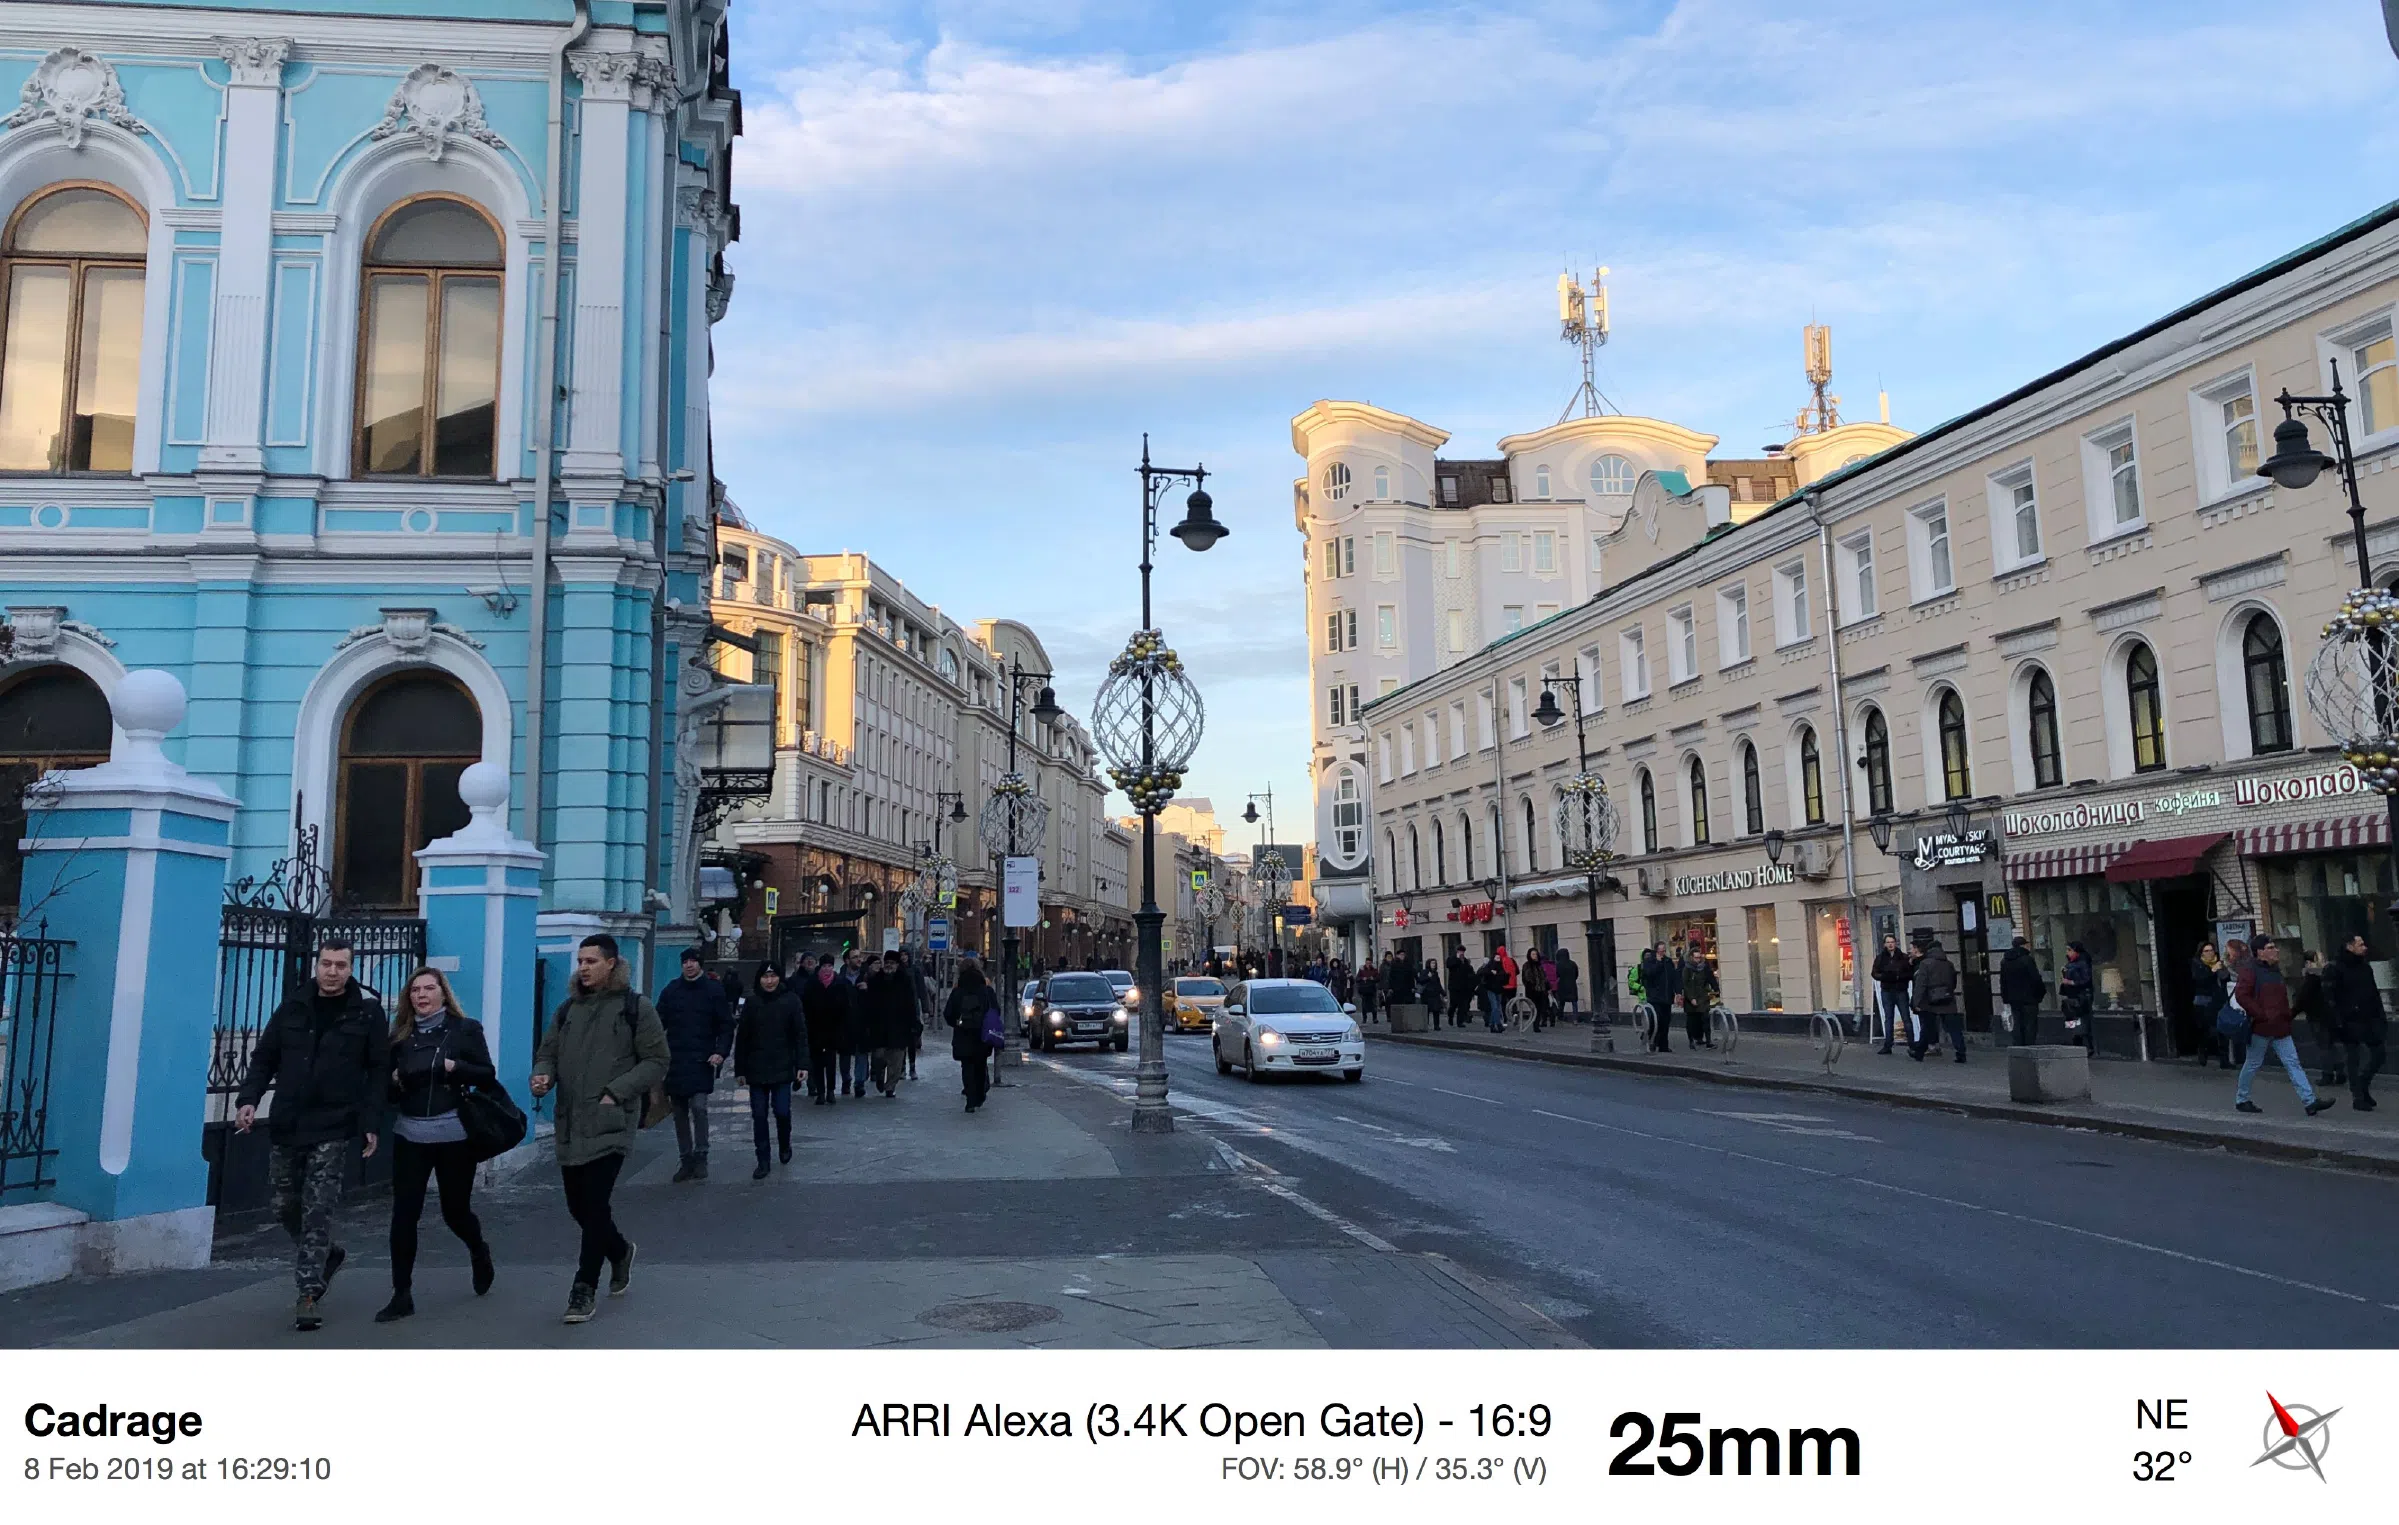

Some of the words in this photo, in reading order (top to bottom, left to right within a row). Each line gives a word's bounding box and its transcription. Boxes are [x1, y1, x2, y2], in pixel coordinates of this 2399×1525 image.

[2154, 790, 2219, 816] кофейня
[2004, 802, 2144, 837] Шоколадница
[1935, 829, 1987, 845] MYASTSKIY
[1674, 870, 1753, 896] KÜCHENLAND
[1757, 864, 1794, 886] HOME
